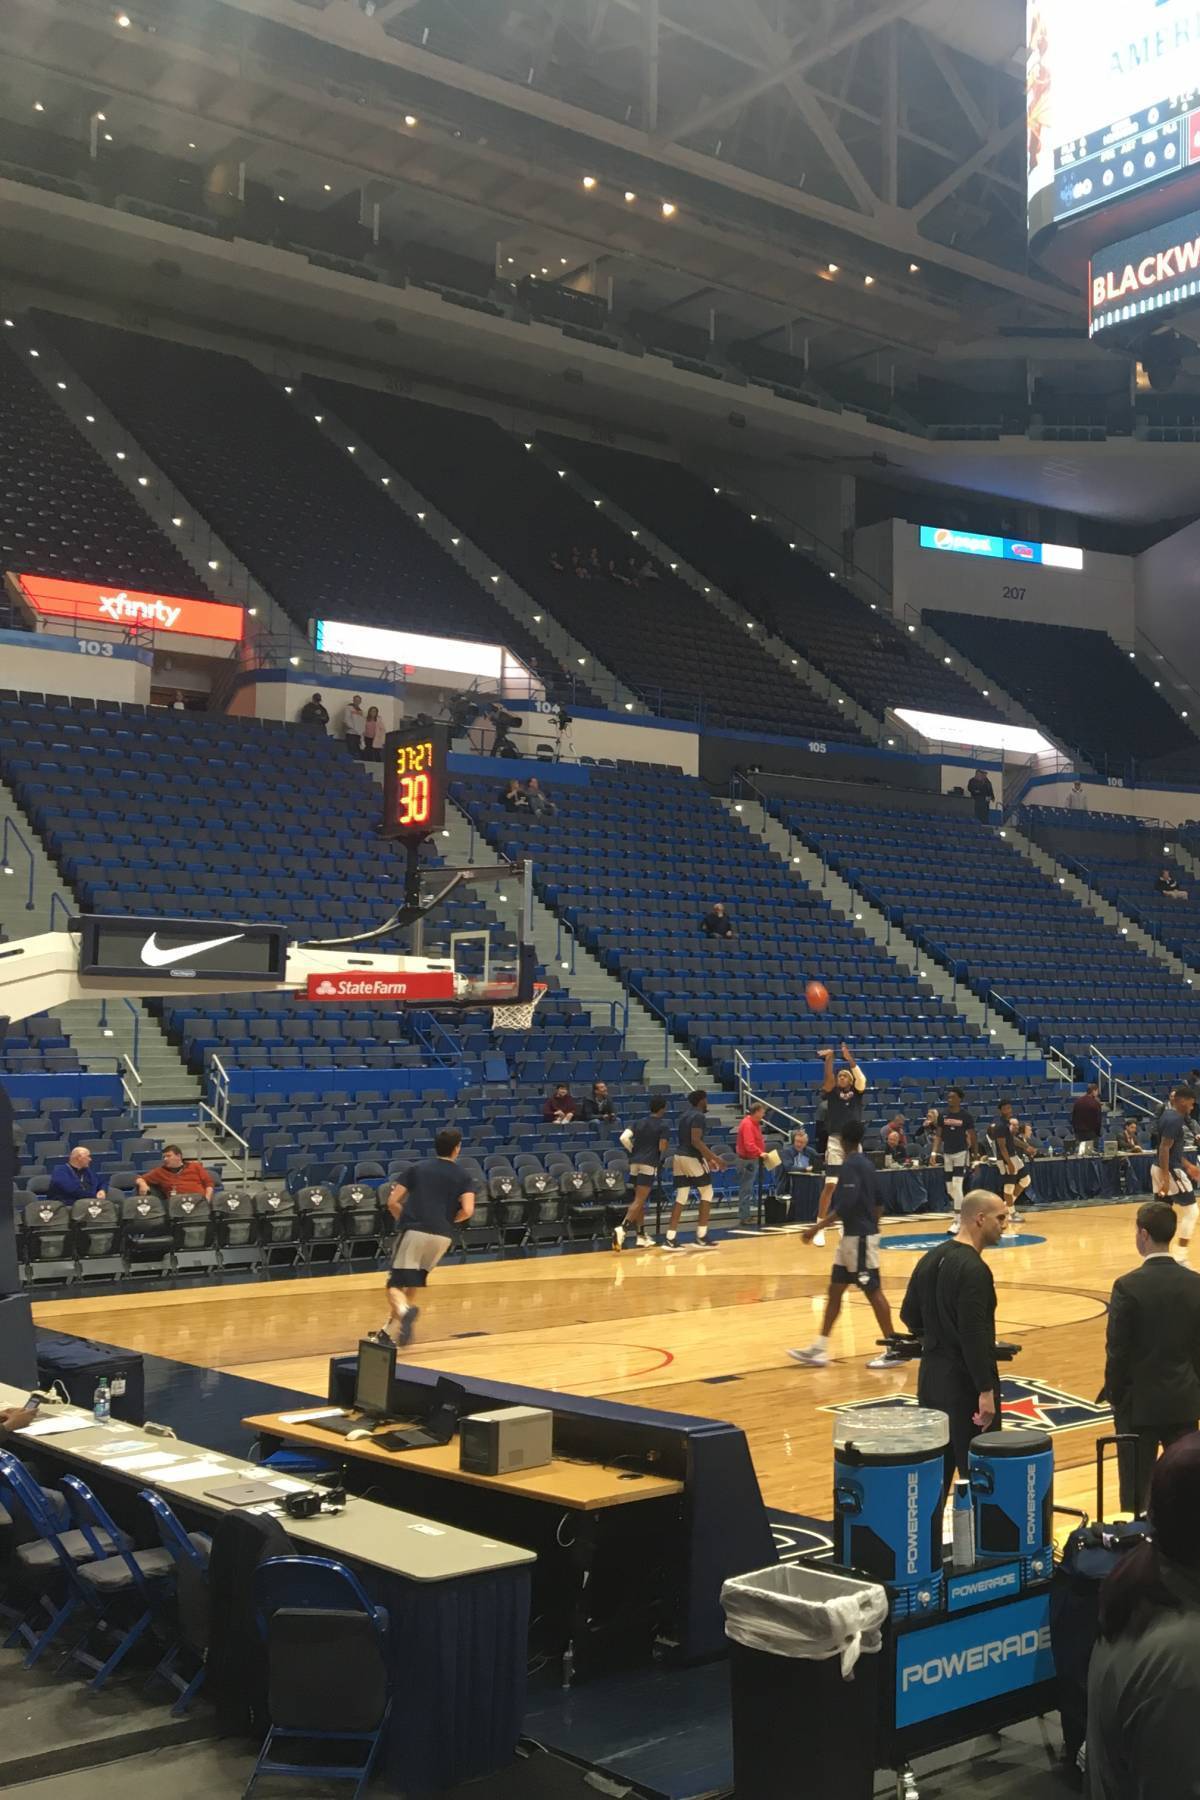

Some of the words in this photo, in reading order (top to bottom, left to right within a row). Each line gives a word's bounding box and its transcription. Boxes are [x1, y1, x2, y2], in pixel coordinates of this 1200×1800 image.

[1002, 586, 1026, 600] 207
[98, 592, 181, 627] xfinity
[78, 640, 114, 658] 103
[534, 702, 561, 713] 104
[397, 743, 432, 774] 37:27
[808, 742, 827, 753] 105
[400, 774, 428, 823] 30
[1026, 1463, 1037, 1545] POWERADE
[907, 1471, 919, 1575] POWERADE
[951, 1572, 1016, 1600] POWERADE
[902, 1626, 1051, 1692] POWERADE
